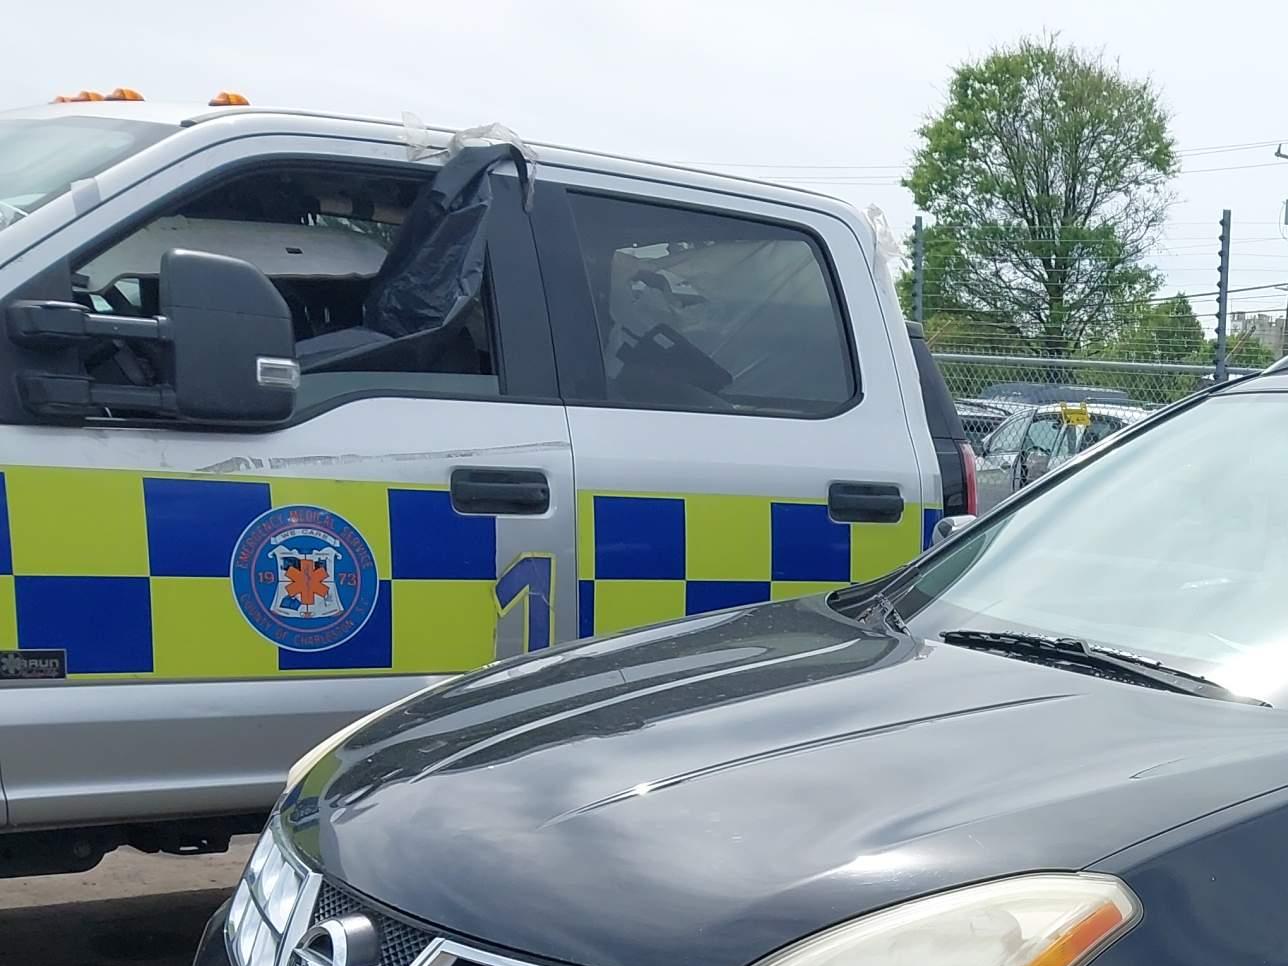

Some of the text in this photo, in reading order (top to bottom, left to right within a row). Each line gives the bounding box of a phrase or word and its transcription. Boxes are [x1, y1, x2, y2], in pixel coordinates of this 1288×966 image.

[288, 511, 335, 529] MEDICAL
[257, 572, 275, 585] 19
[338, 572, 358, 586] 73
